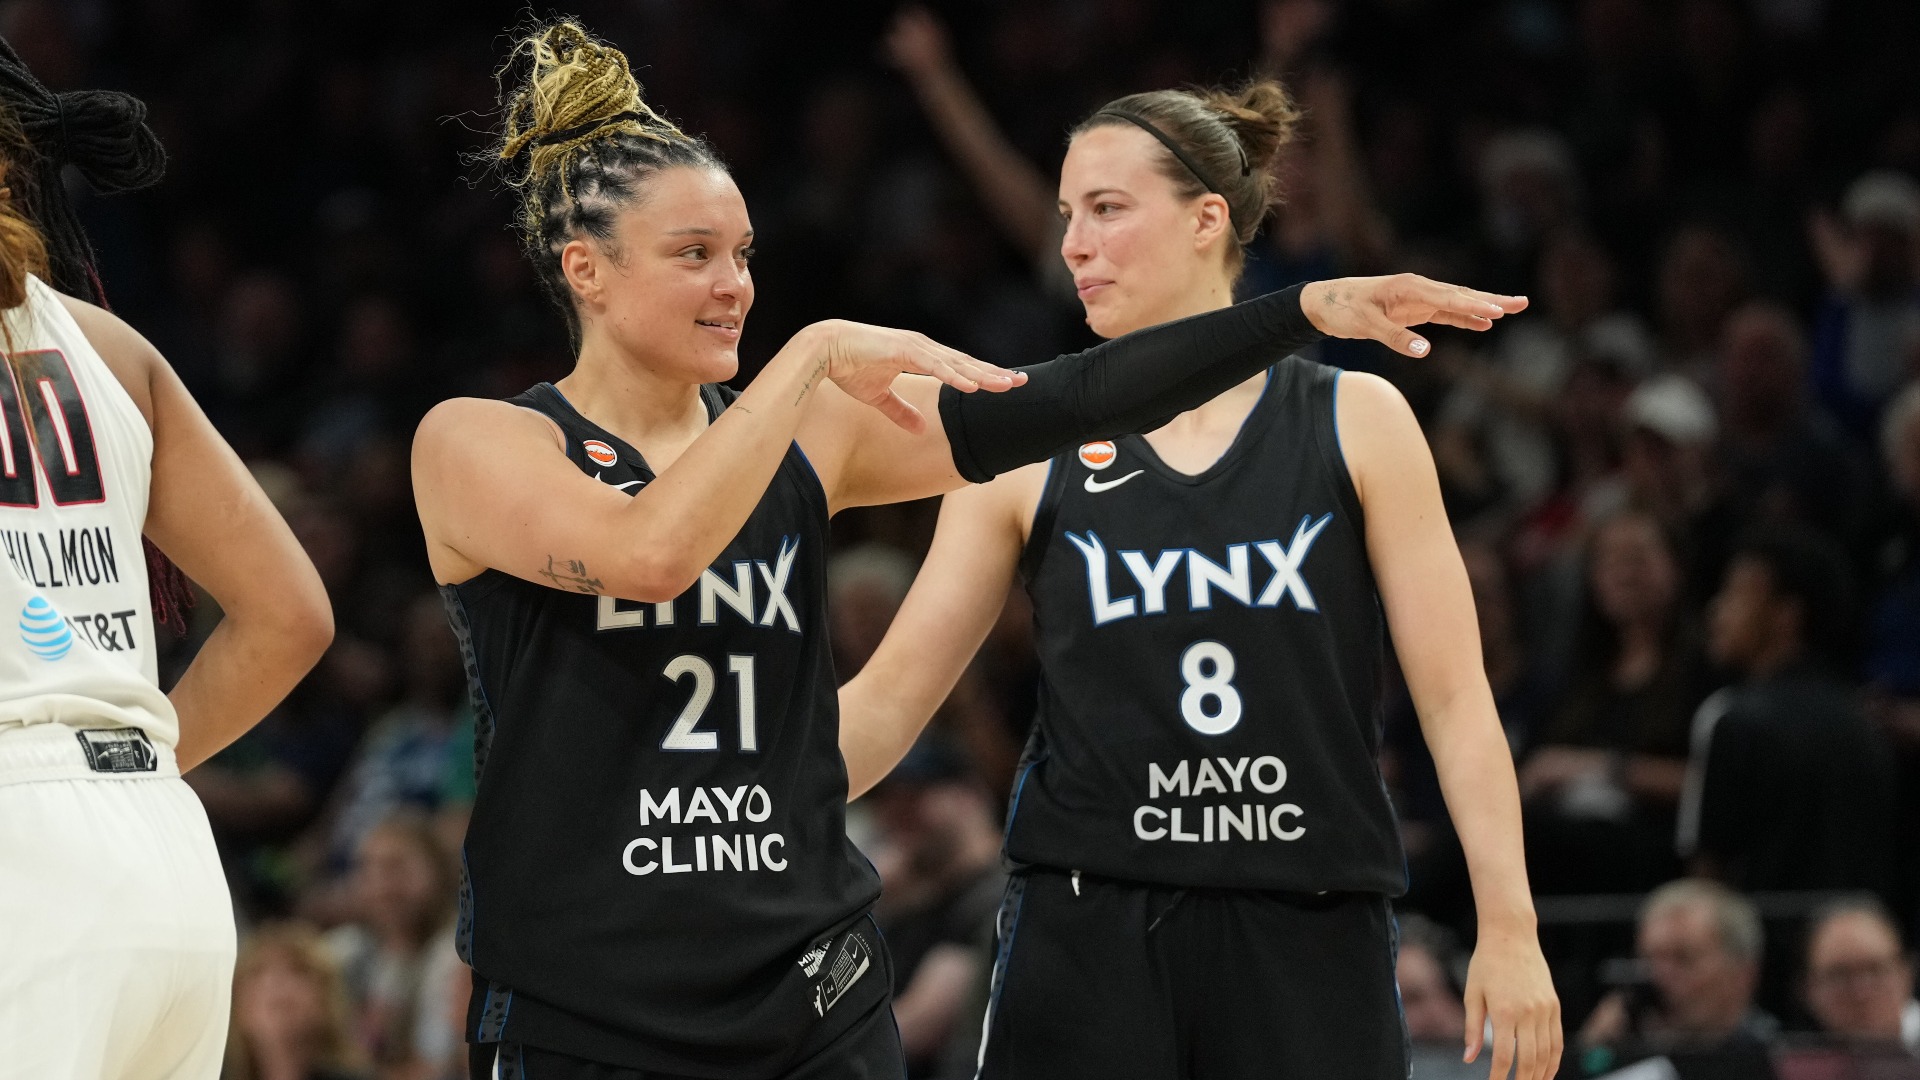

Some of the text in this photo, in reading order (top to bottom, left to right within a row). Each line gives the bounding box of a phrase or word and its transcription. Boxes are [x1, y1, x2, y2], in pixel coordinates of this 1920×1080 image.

[0, 526, 119, 587] HILLMON
[1065, 512, 1333, 627] LYNX
[659, 652, 759, 753] 21
[1179, 639, 1243, 736] 8
[1148, 755, 1287, 798] MAYO
[639, 784, 772, 826] MAYO
[1133, 803, 1306, 843] CLINIC
[622, 833, 788, 876] CLINIC
